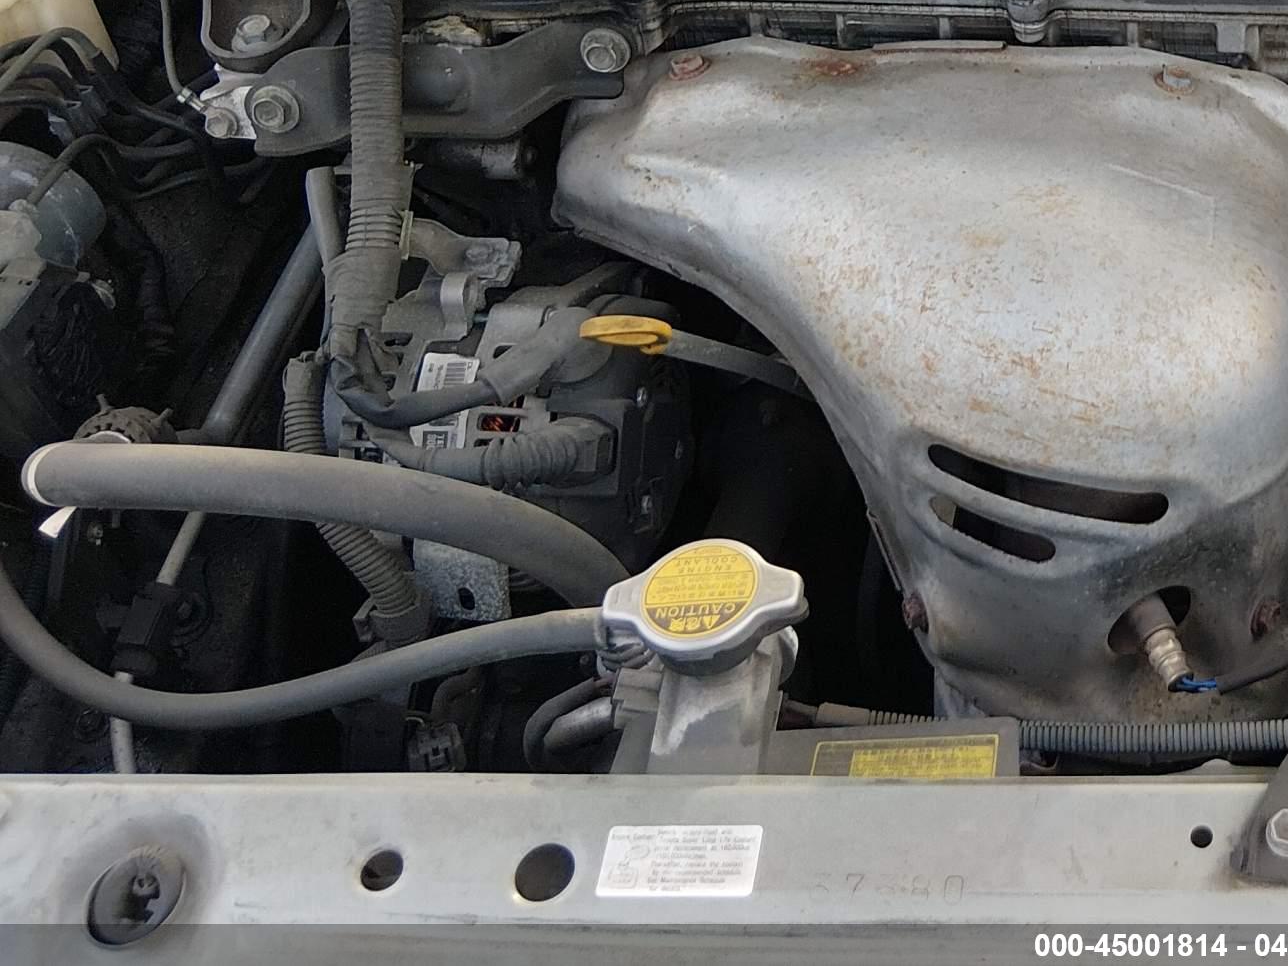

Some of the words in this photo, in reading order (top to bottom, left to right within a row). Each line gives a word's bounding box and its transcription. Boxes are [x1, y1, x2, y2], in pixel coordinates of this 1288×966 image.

[675, 555, 737, 567] COOLANT
[678, 564, 730, 573] ENGINE
[655, 601, 735, 618] CAUTION
